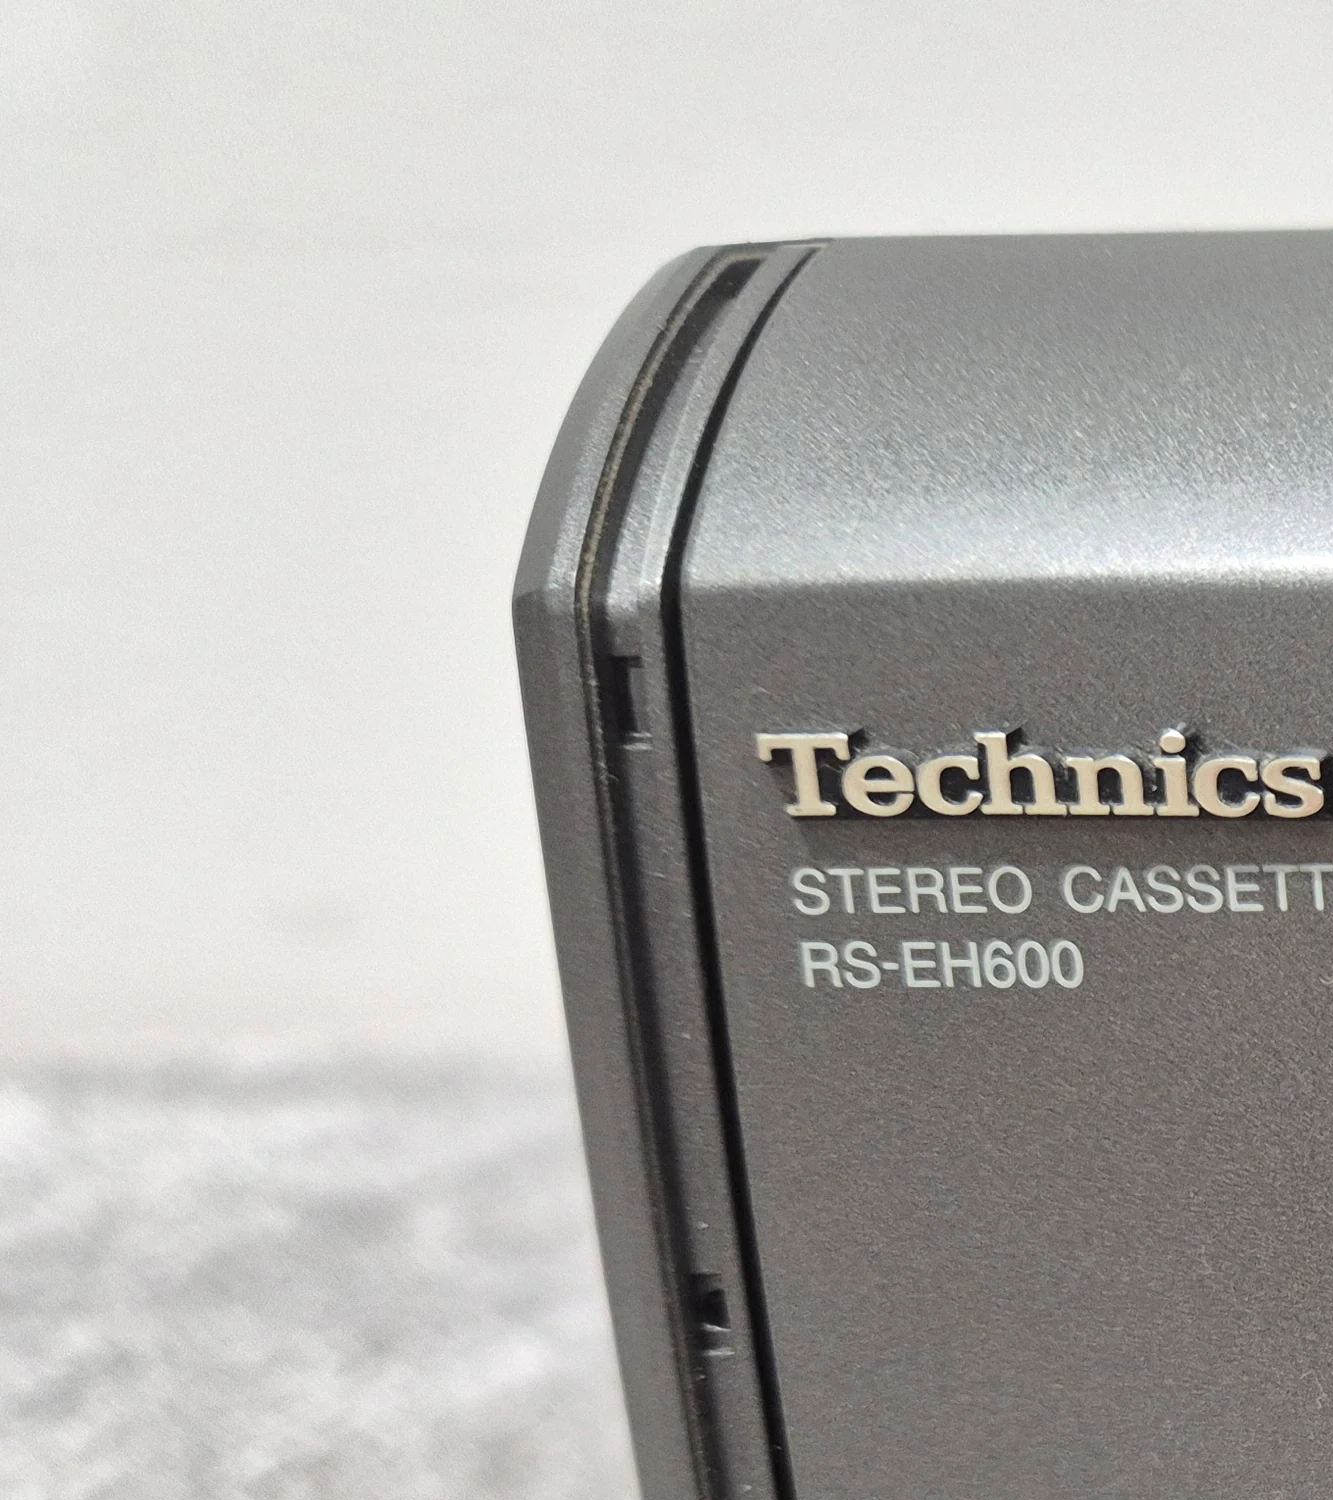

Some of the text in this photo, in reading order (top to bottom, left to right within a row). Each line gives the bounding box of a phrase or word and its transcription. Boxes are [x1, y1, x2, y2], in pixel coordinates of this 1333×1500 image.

[756, 730, 1325, 819] Technics
[794, 866, 1033, 917] STEREO
[800, 939, 1085, 990] RS-EH600
